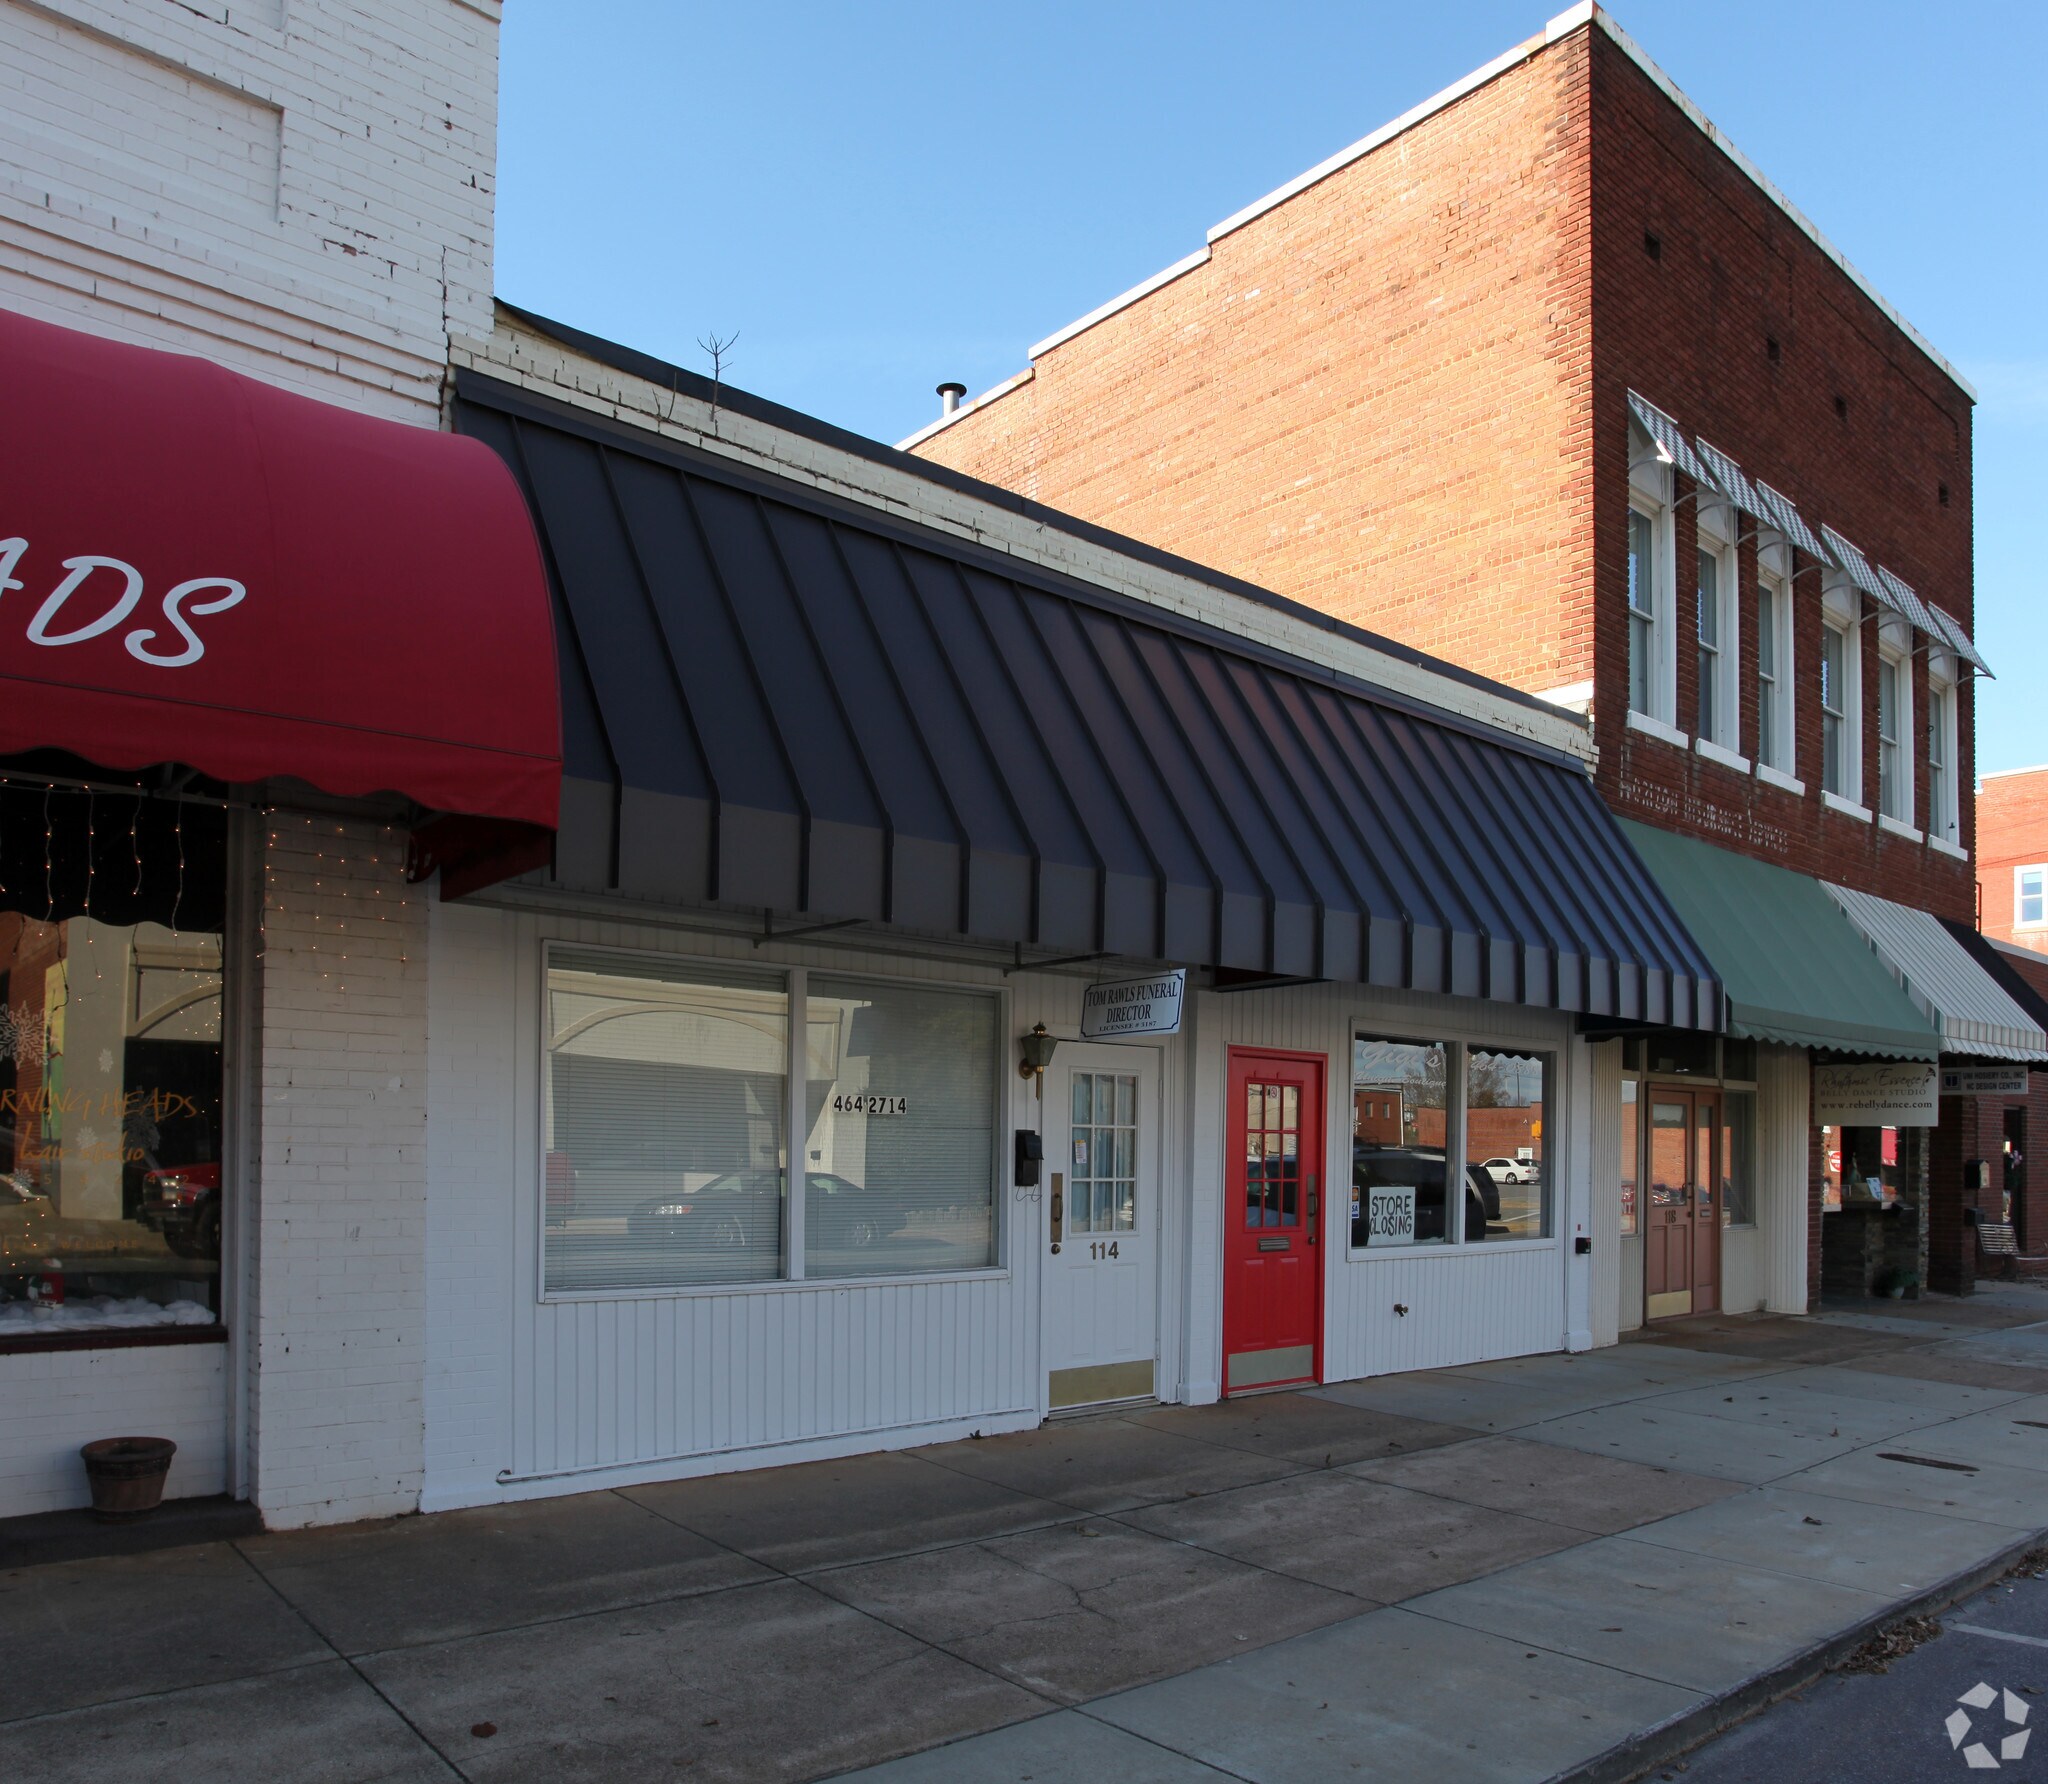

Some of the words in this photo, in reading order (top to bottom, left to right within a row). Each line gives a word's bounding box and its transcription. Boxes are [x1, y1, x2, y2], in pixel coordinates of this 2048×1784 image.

[1088, 991, 1107, 1007] TOM
[1108, 986, 1135, 1004] RAWLS
[1136, 981, 1177, 1001] FUNERAL
[1106, 1004, 1151, 1023] DIRECTOR
[1975, 1071, 1999, 1080] HOSIERY
[1820, 1089, 1849, 1097] BELLY
[1853, 1089, 1886, 1097] DANCE
[1889, 1088, 1926, 1096] STUDIO
[1976, 1082, 1997, 1090] DESIGN
[1998, 1082, 2022, 1090] CENTER
[99, 1087, 198, 1122] HEADS
[833, 1095, 863, 1112] 464
[868, 1097, 907, 1114] 2714
[1821, 1100, 1932, 1110] www.rebellydance.com
[1371, 1195, 1412, 1217] STORE
[1369, 1215, 1412, 1237] CLOSING
[1665, 1209, 1677, 1224] 118
[1089, 1241, 1119, 1260] 114
